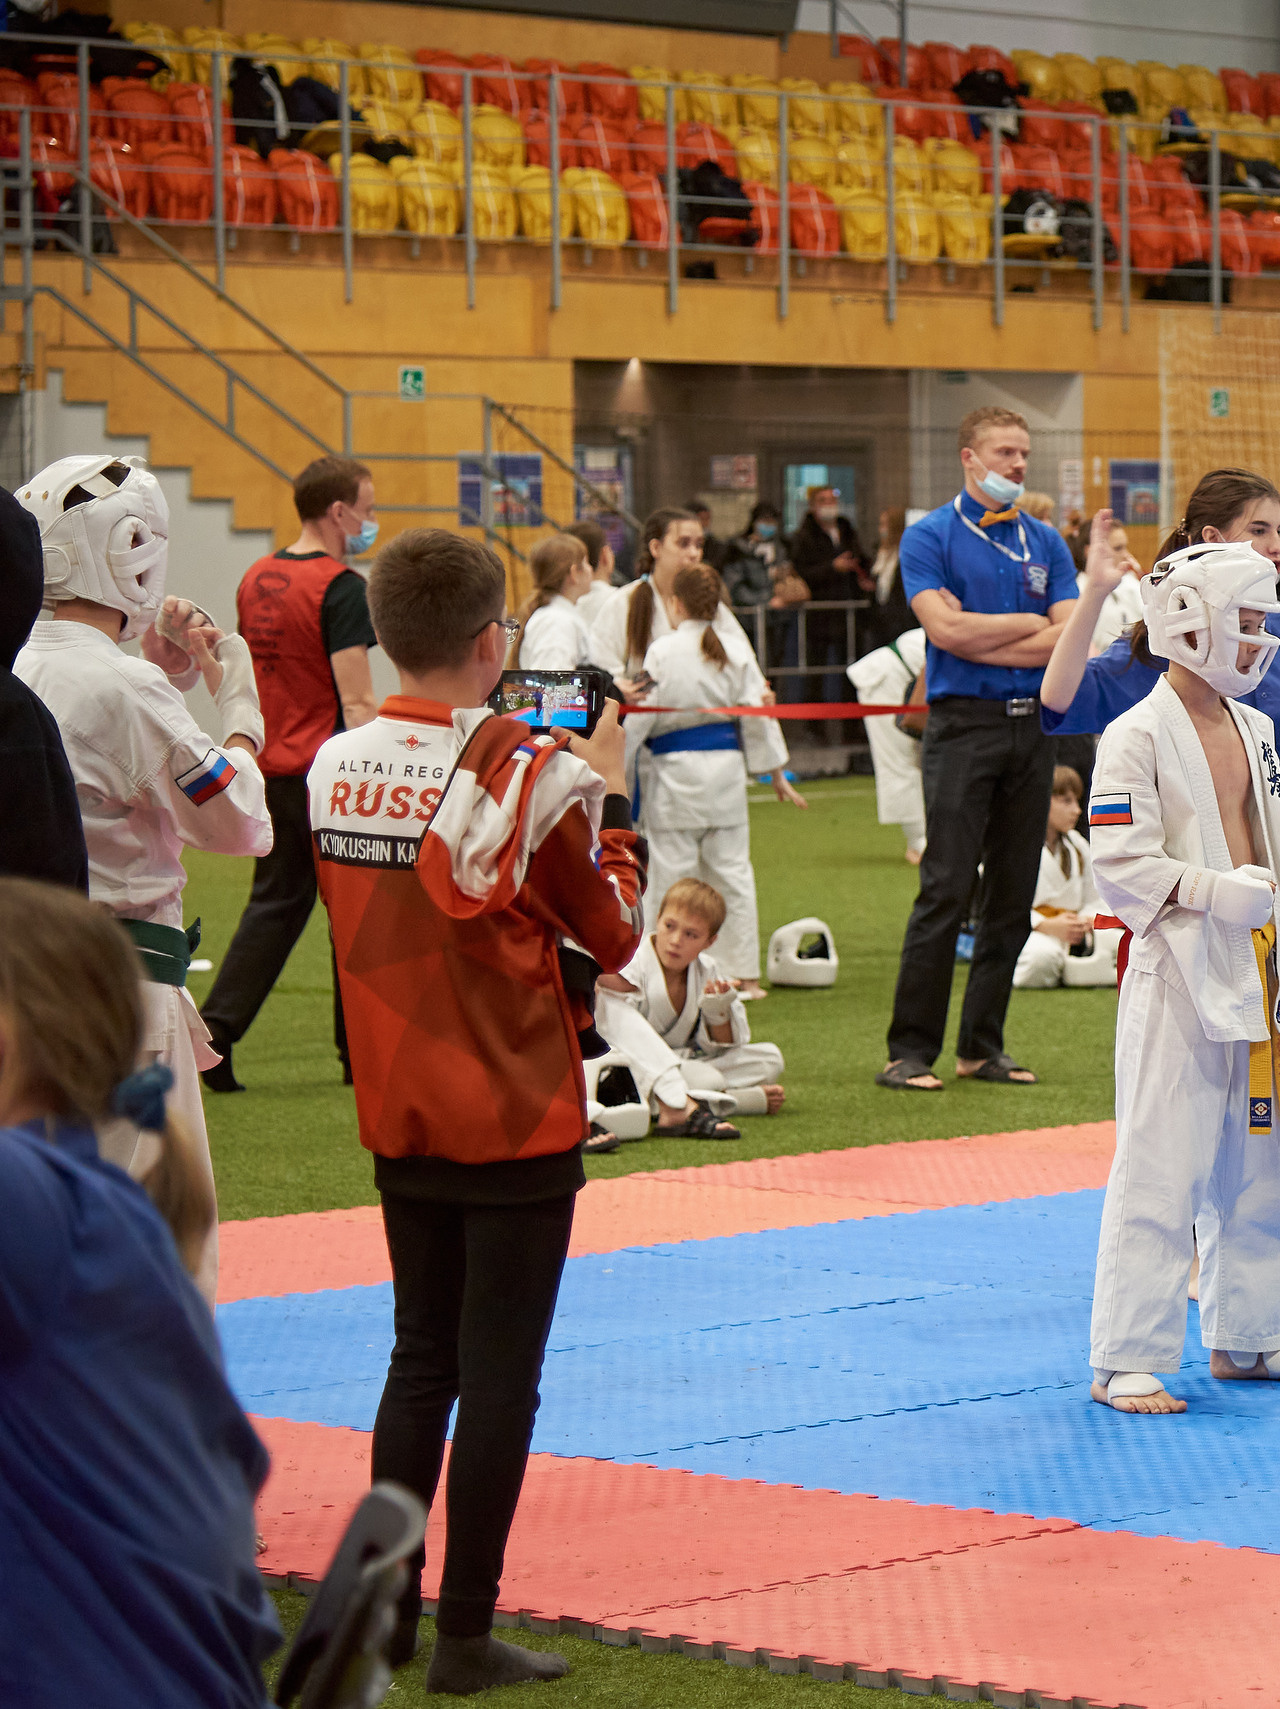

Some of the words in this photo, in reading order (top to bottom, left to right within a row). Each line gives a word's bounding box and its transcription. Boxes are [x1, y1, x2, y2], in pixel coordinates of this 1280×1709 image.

[338, 760, 393, 776] ALTAI
[403, 764, 444, 779] REG
[328, 777, 443, 822] RUSS
[320, 832, 391, 862] KYOKUSHIN
